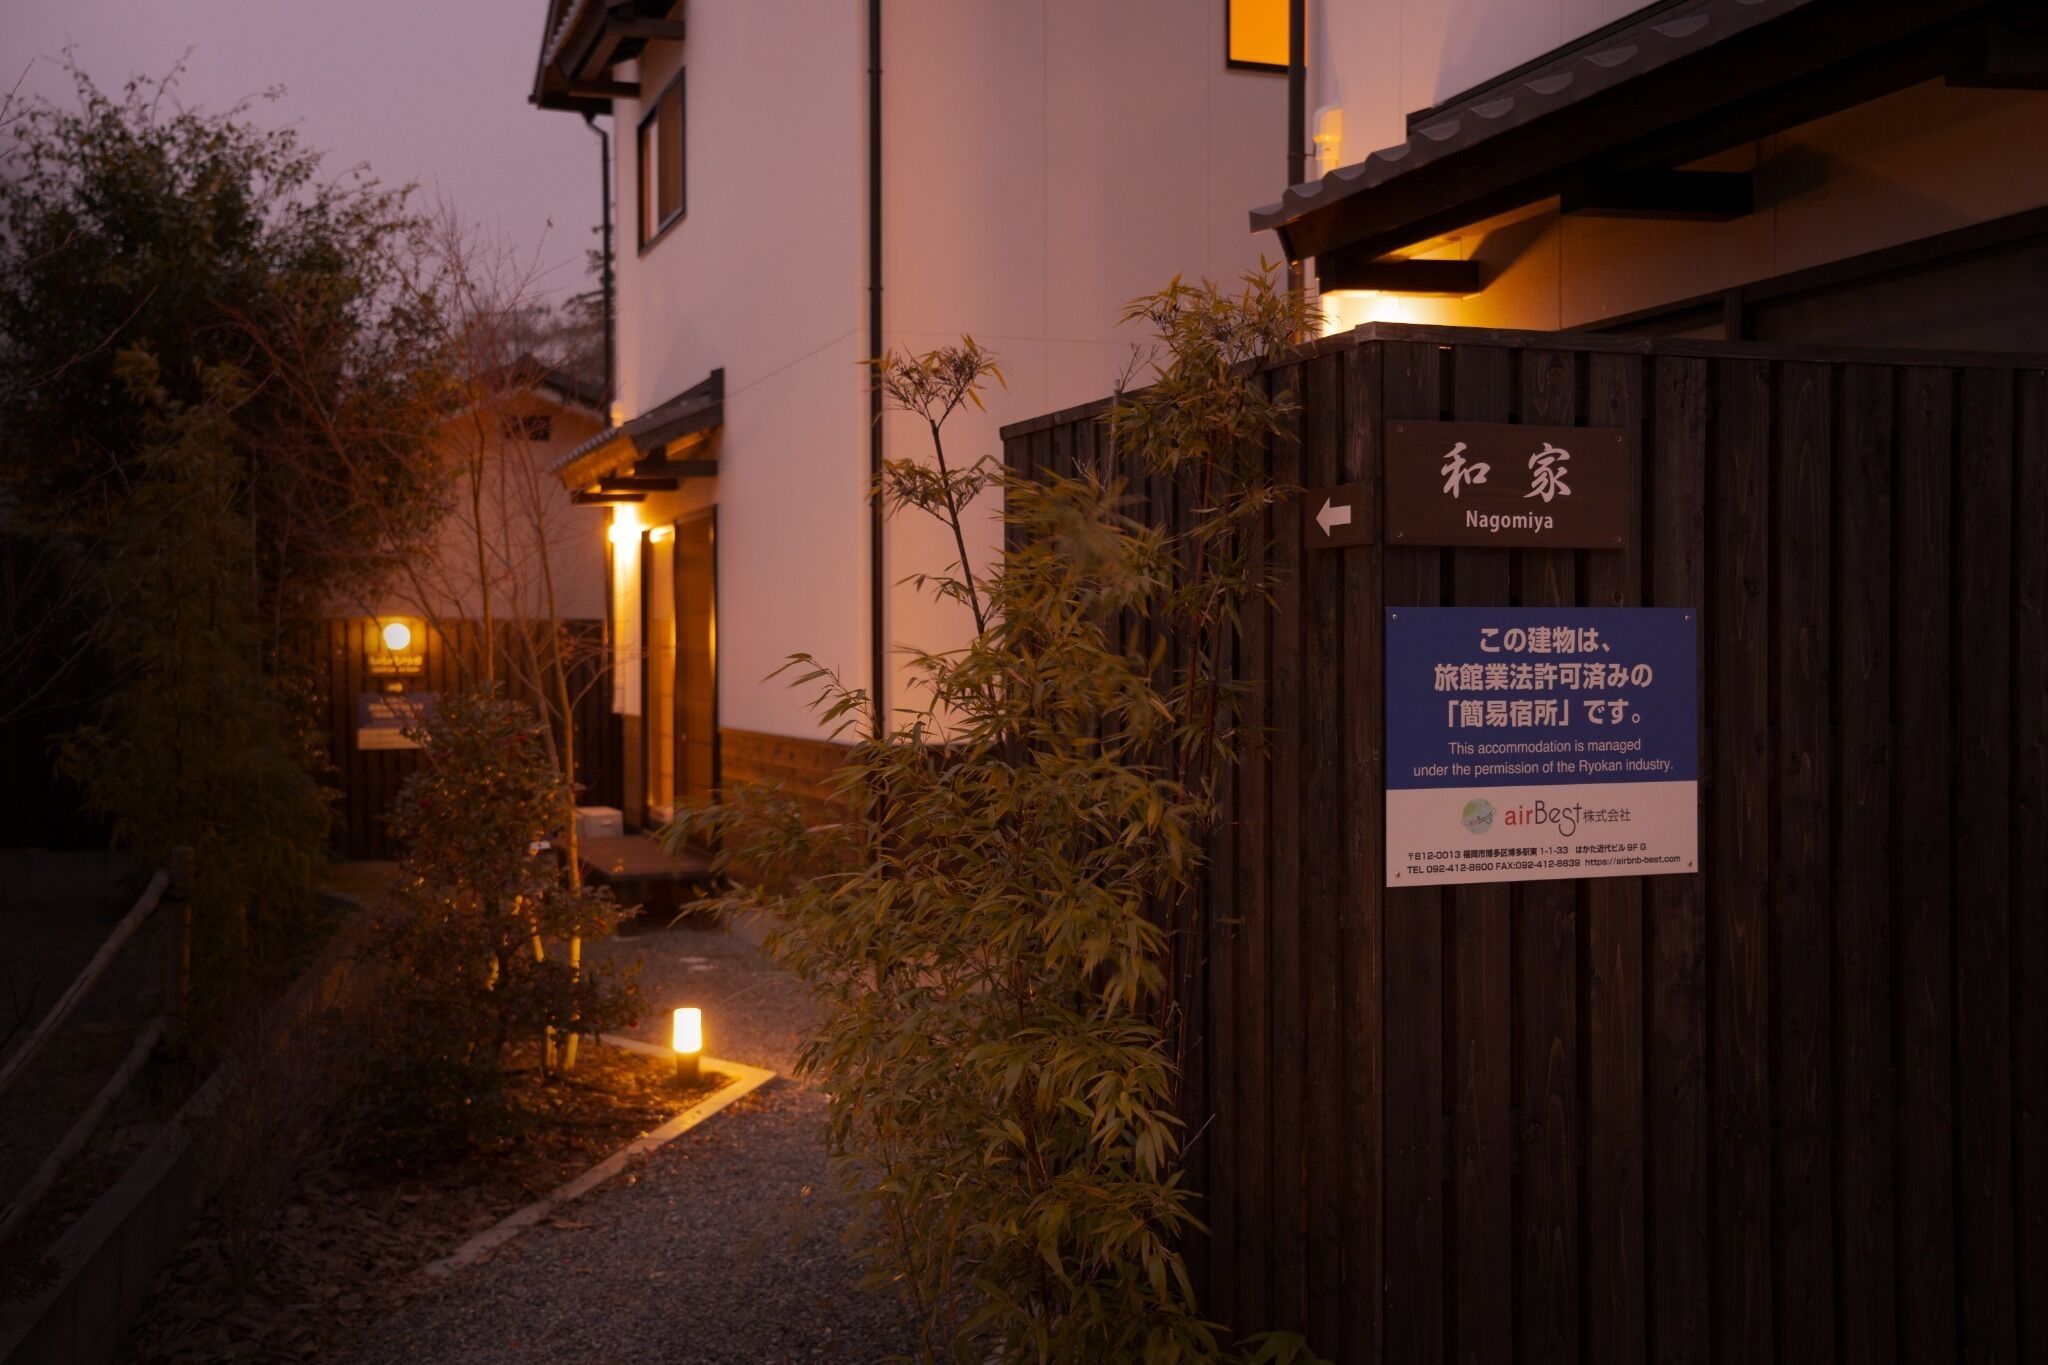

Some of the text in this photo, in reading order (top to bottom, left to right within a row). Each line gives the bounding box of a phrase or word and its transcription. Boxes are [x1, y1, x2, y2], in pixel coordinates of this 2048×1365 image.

[1441, 442, 1572, 503] 和家
[1466, 510, 1553, 533] Nagomiya
[1480, 626, 1611, 654] この建物は、
[1434, 663, 1653, 691] 旅館業法許可済みの
[1448, 738, 1641, 755] This accommodation is managed
[1413, 758, 1674, 777] under the permission of the Ryokan industry.
[1504, 800, 1631, 837] airBest 株式会社
[1540, 846, 1569, 855] 1-1-33
[1407, 866, 1424, 874] TEL
